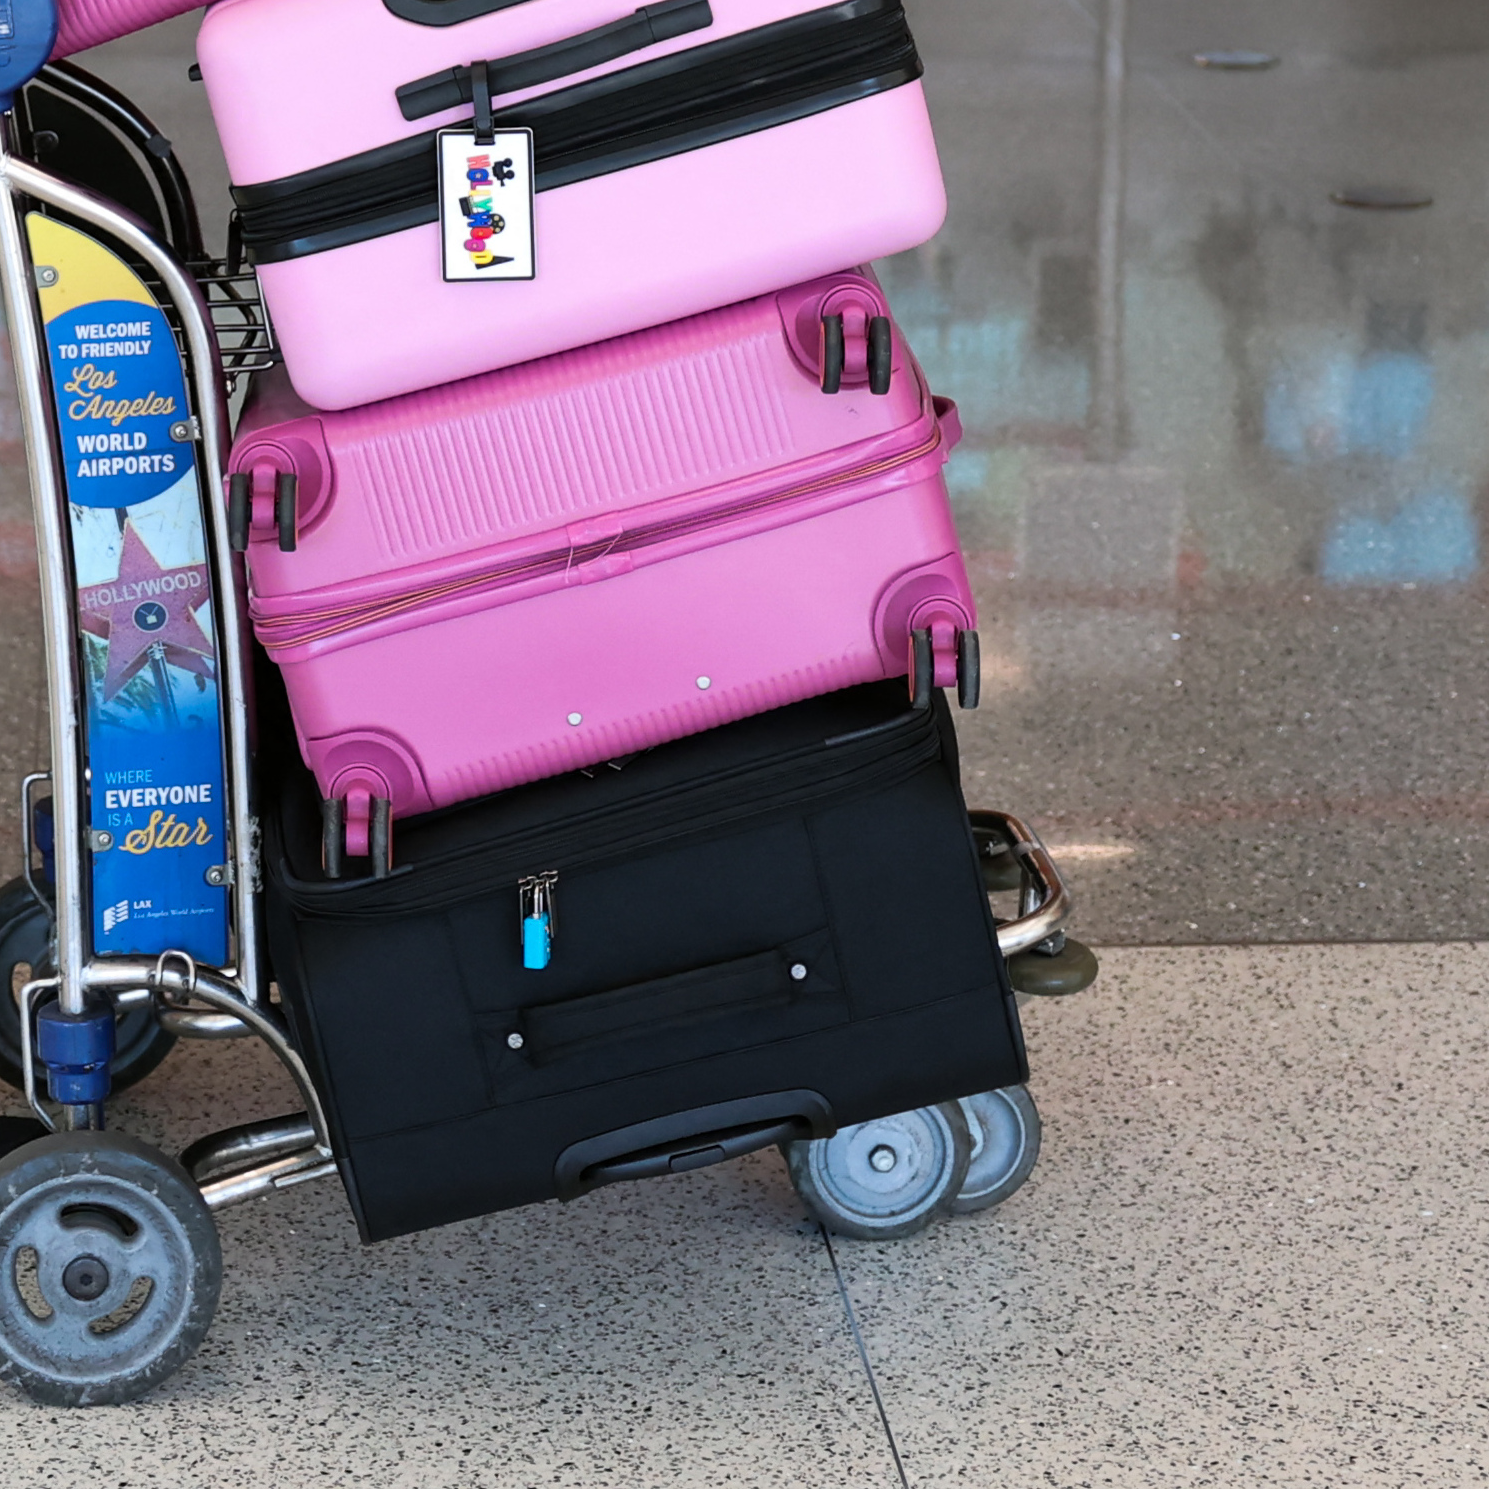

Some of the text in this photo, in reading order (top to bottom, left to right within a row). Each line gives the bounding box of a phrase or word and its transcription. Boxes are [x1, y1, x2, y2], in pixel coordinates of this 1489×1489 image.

[464, 154, 494, 264] HOLLYWOOD
[75, 322, 151, 340] WELCOME
[58, 340, 152, 359] TO FRIENDLY
[65, 363, 117, 398] Los
[68, 391, 176, 427] Angeles
[76, 432, 147, 454] WORLD
[76, 454, 175, 477] AIRPORTS
[83, 571, 201, 609] HOLLYWOOD
[105, 769, 153, 785] WHERE
[105, 784, 212, 809] EVERYONE
[108, 809, 214, 854] IS A Star
[133, 899, 152, 909] LAX
